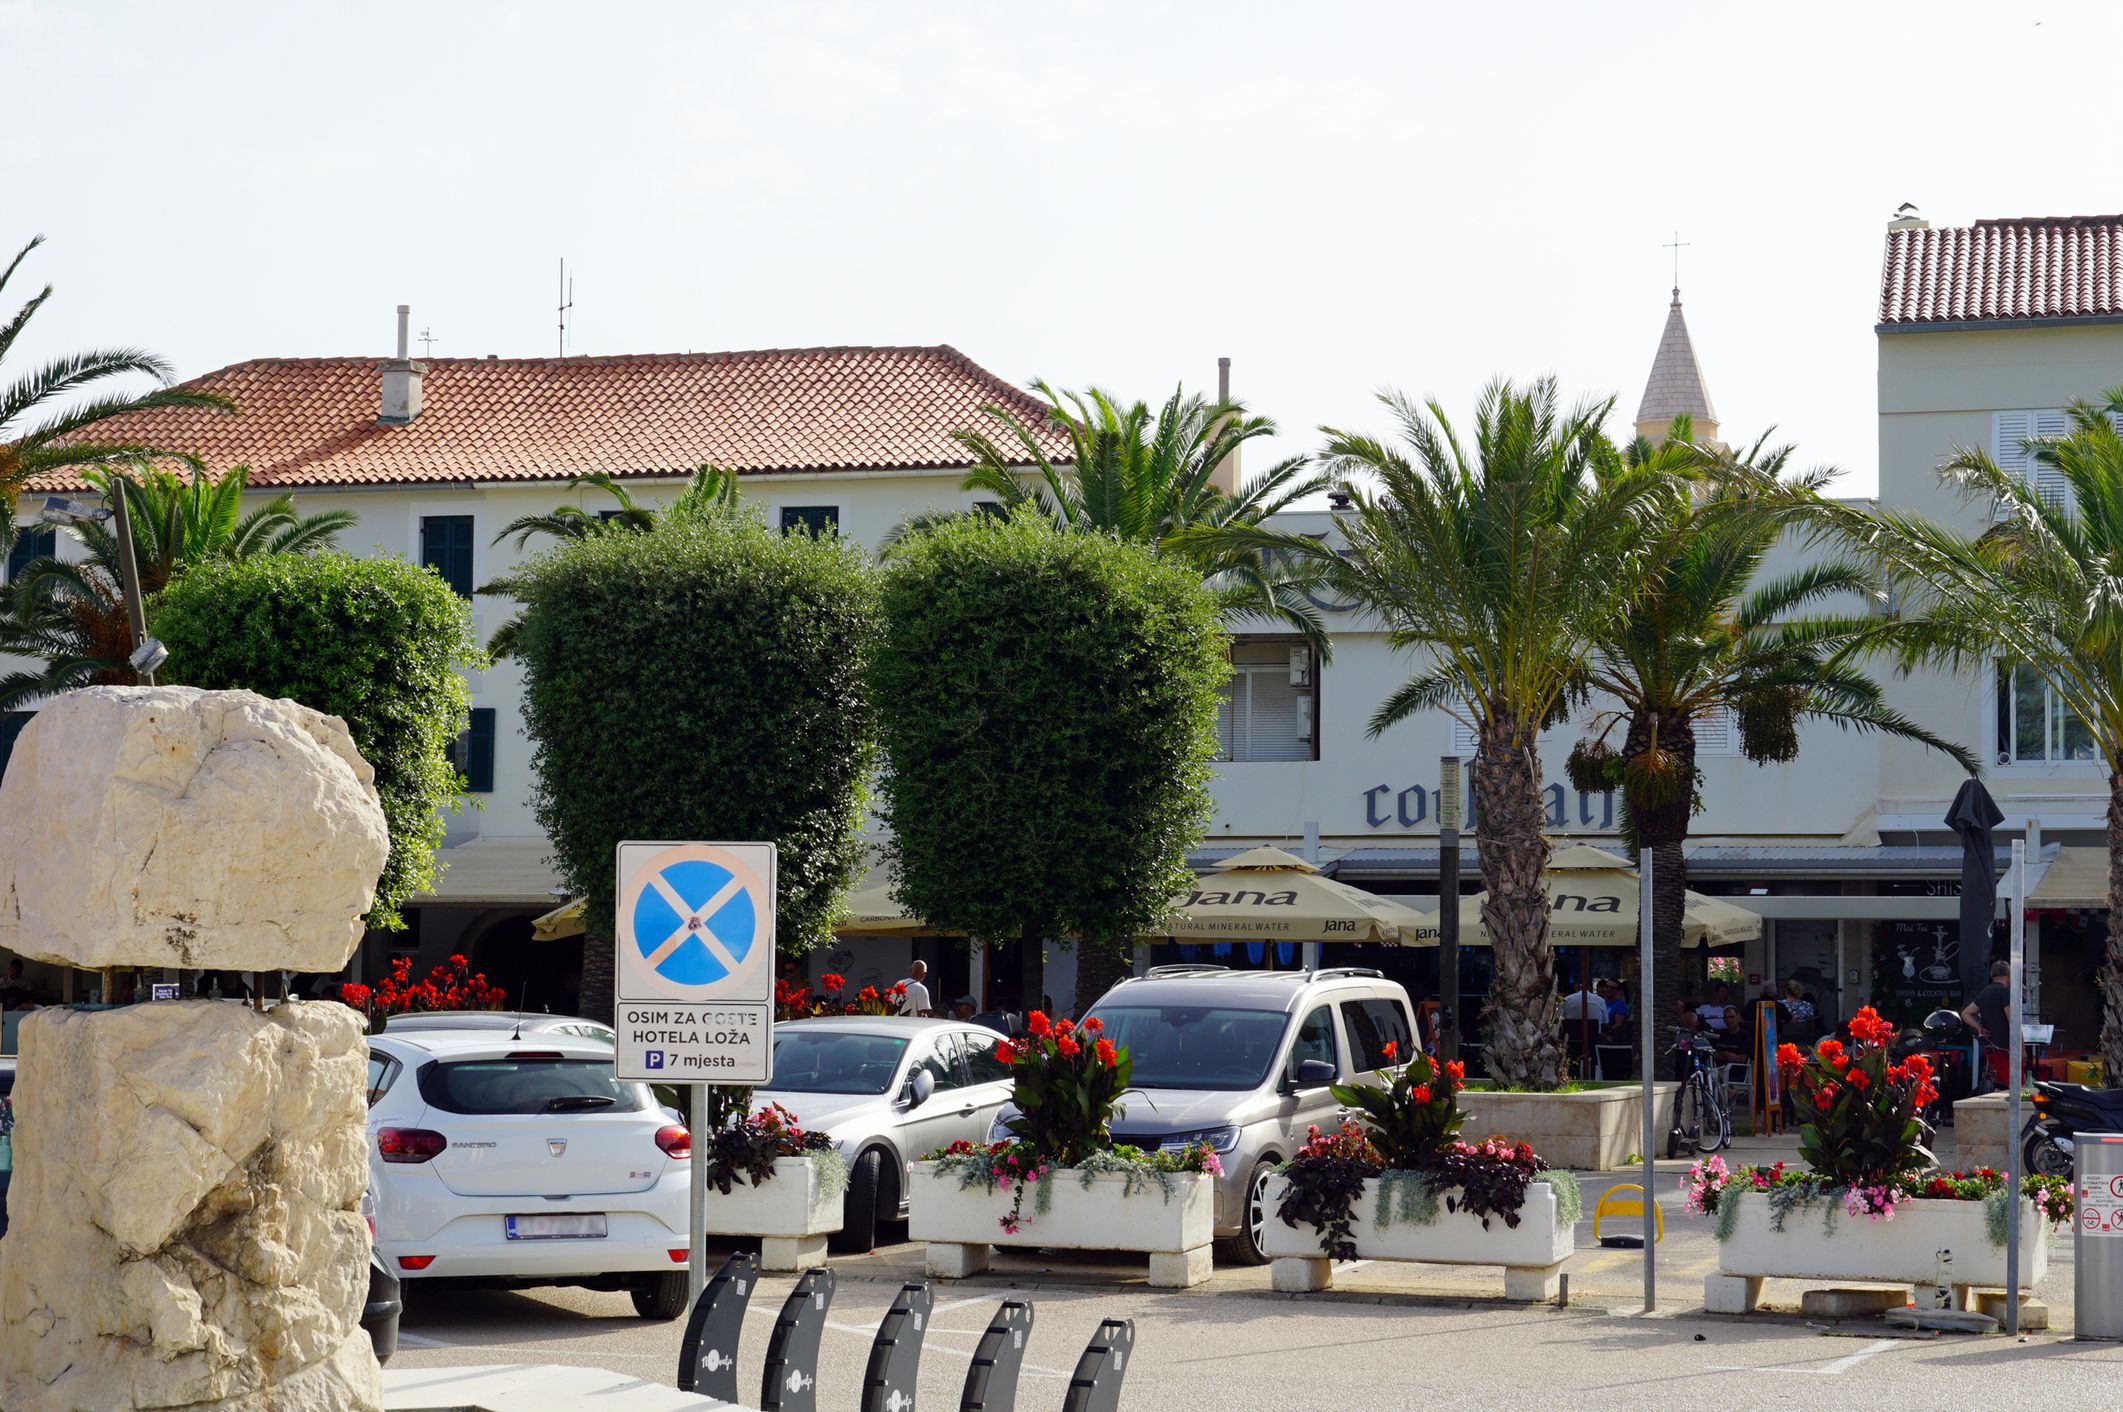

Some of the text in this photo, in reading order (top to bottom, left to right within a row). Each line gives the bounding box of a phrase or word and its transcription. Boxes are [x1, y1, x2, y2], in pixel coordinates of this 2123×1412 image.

[1166, 922, 1290, 931] ATURAL MINERAL WATER
[1579, 930, 1616, 938] WATER
[627, 1011, 757, 1026] OSIM ZA GOSTE
[633, 1028, 751, 1045] HOTELA LOŽA
[670, 1053, 678, 1066] 7
[684, 1054, 735, 1069] mjesta
